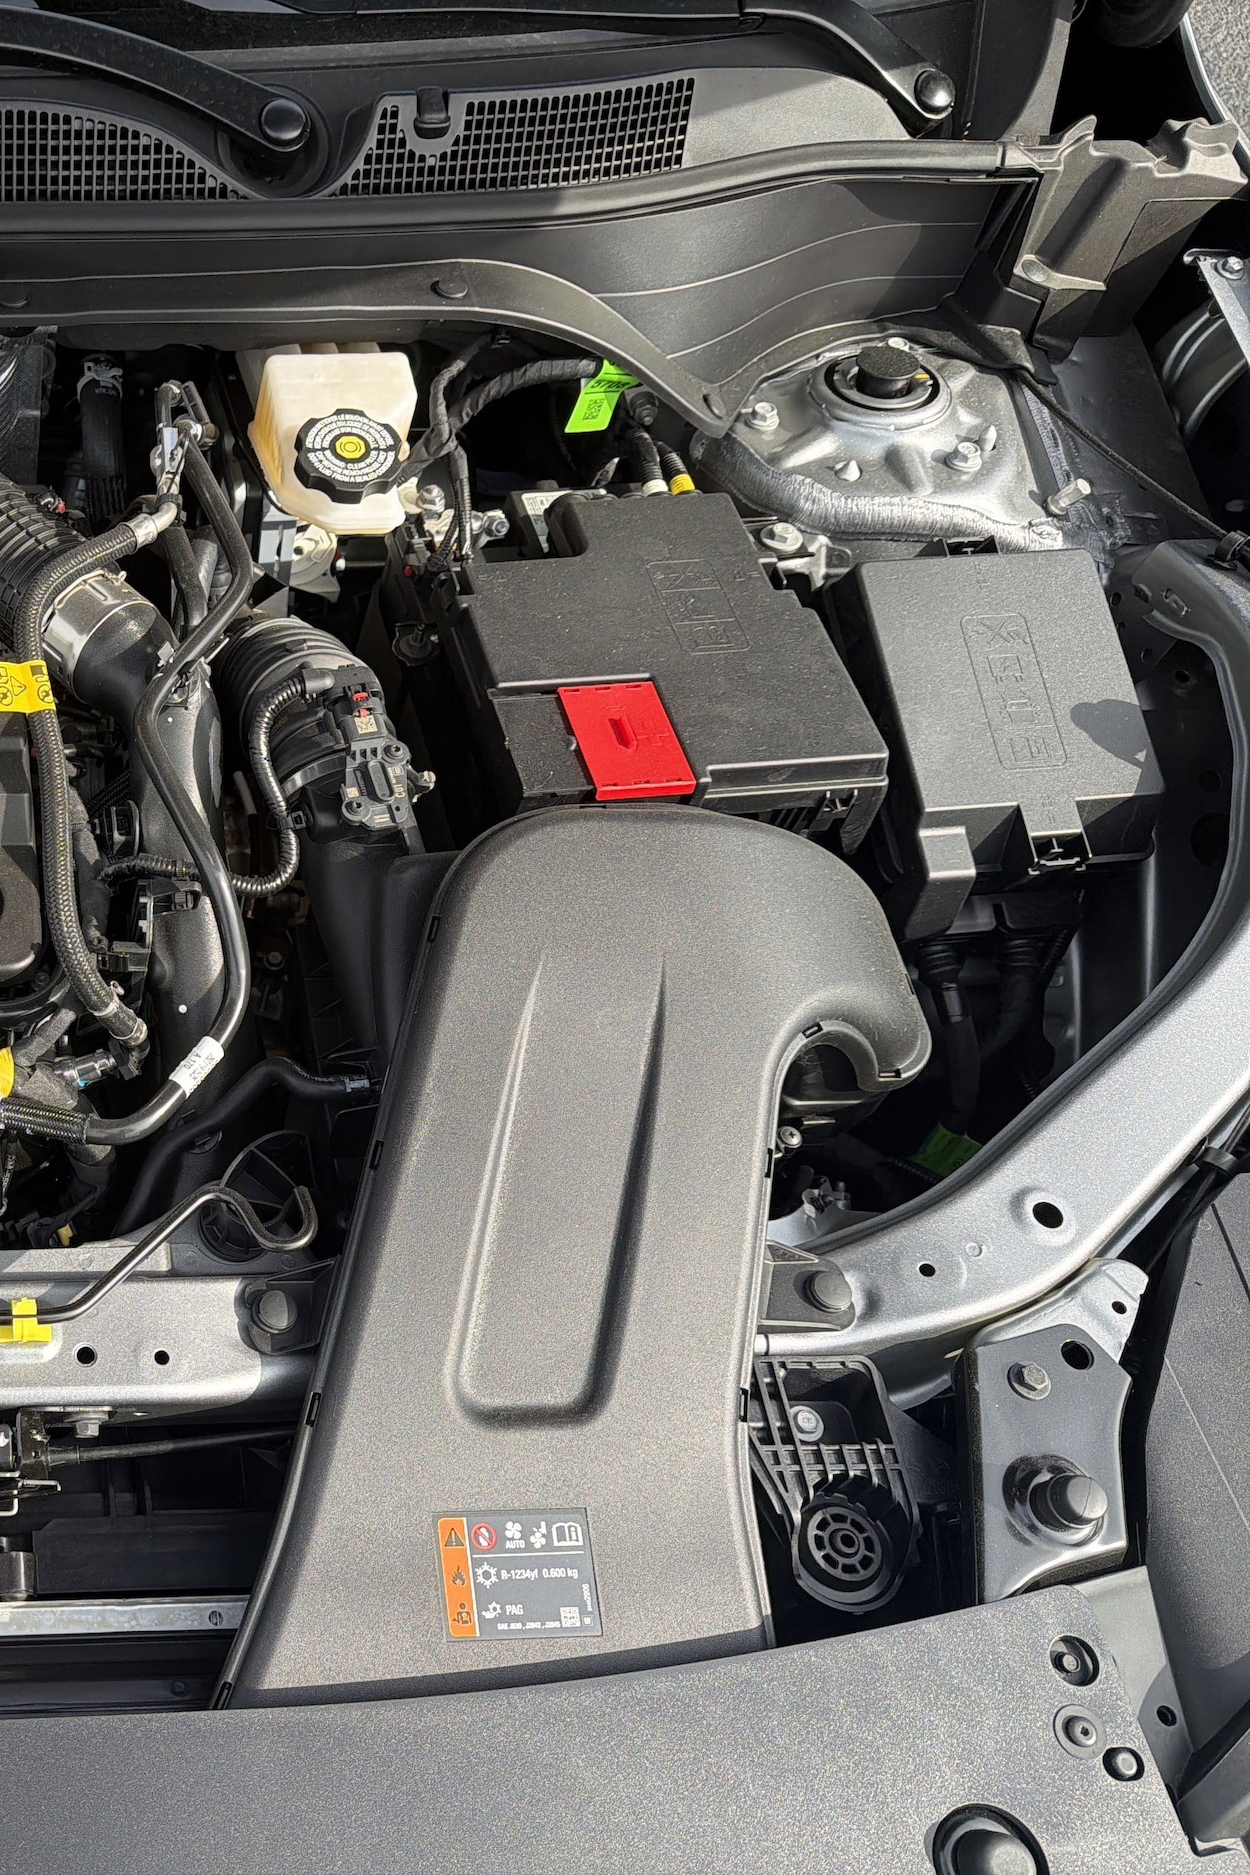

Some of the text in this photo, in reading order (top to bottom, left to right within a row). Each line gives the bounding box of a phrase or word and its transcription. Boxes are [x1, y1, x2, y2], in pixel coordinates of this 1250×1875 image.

[346, 460, 367, 469] CLEAN
[314, 464, 332, 477] FLUID
[329, 472, 348, 481] FROM
[505, 1539, 526, 1549] AUTO
[501, 1567, 579, 1581] R-1234yf 0.600 kg
[505, 1604, 524, 1616] PAG
